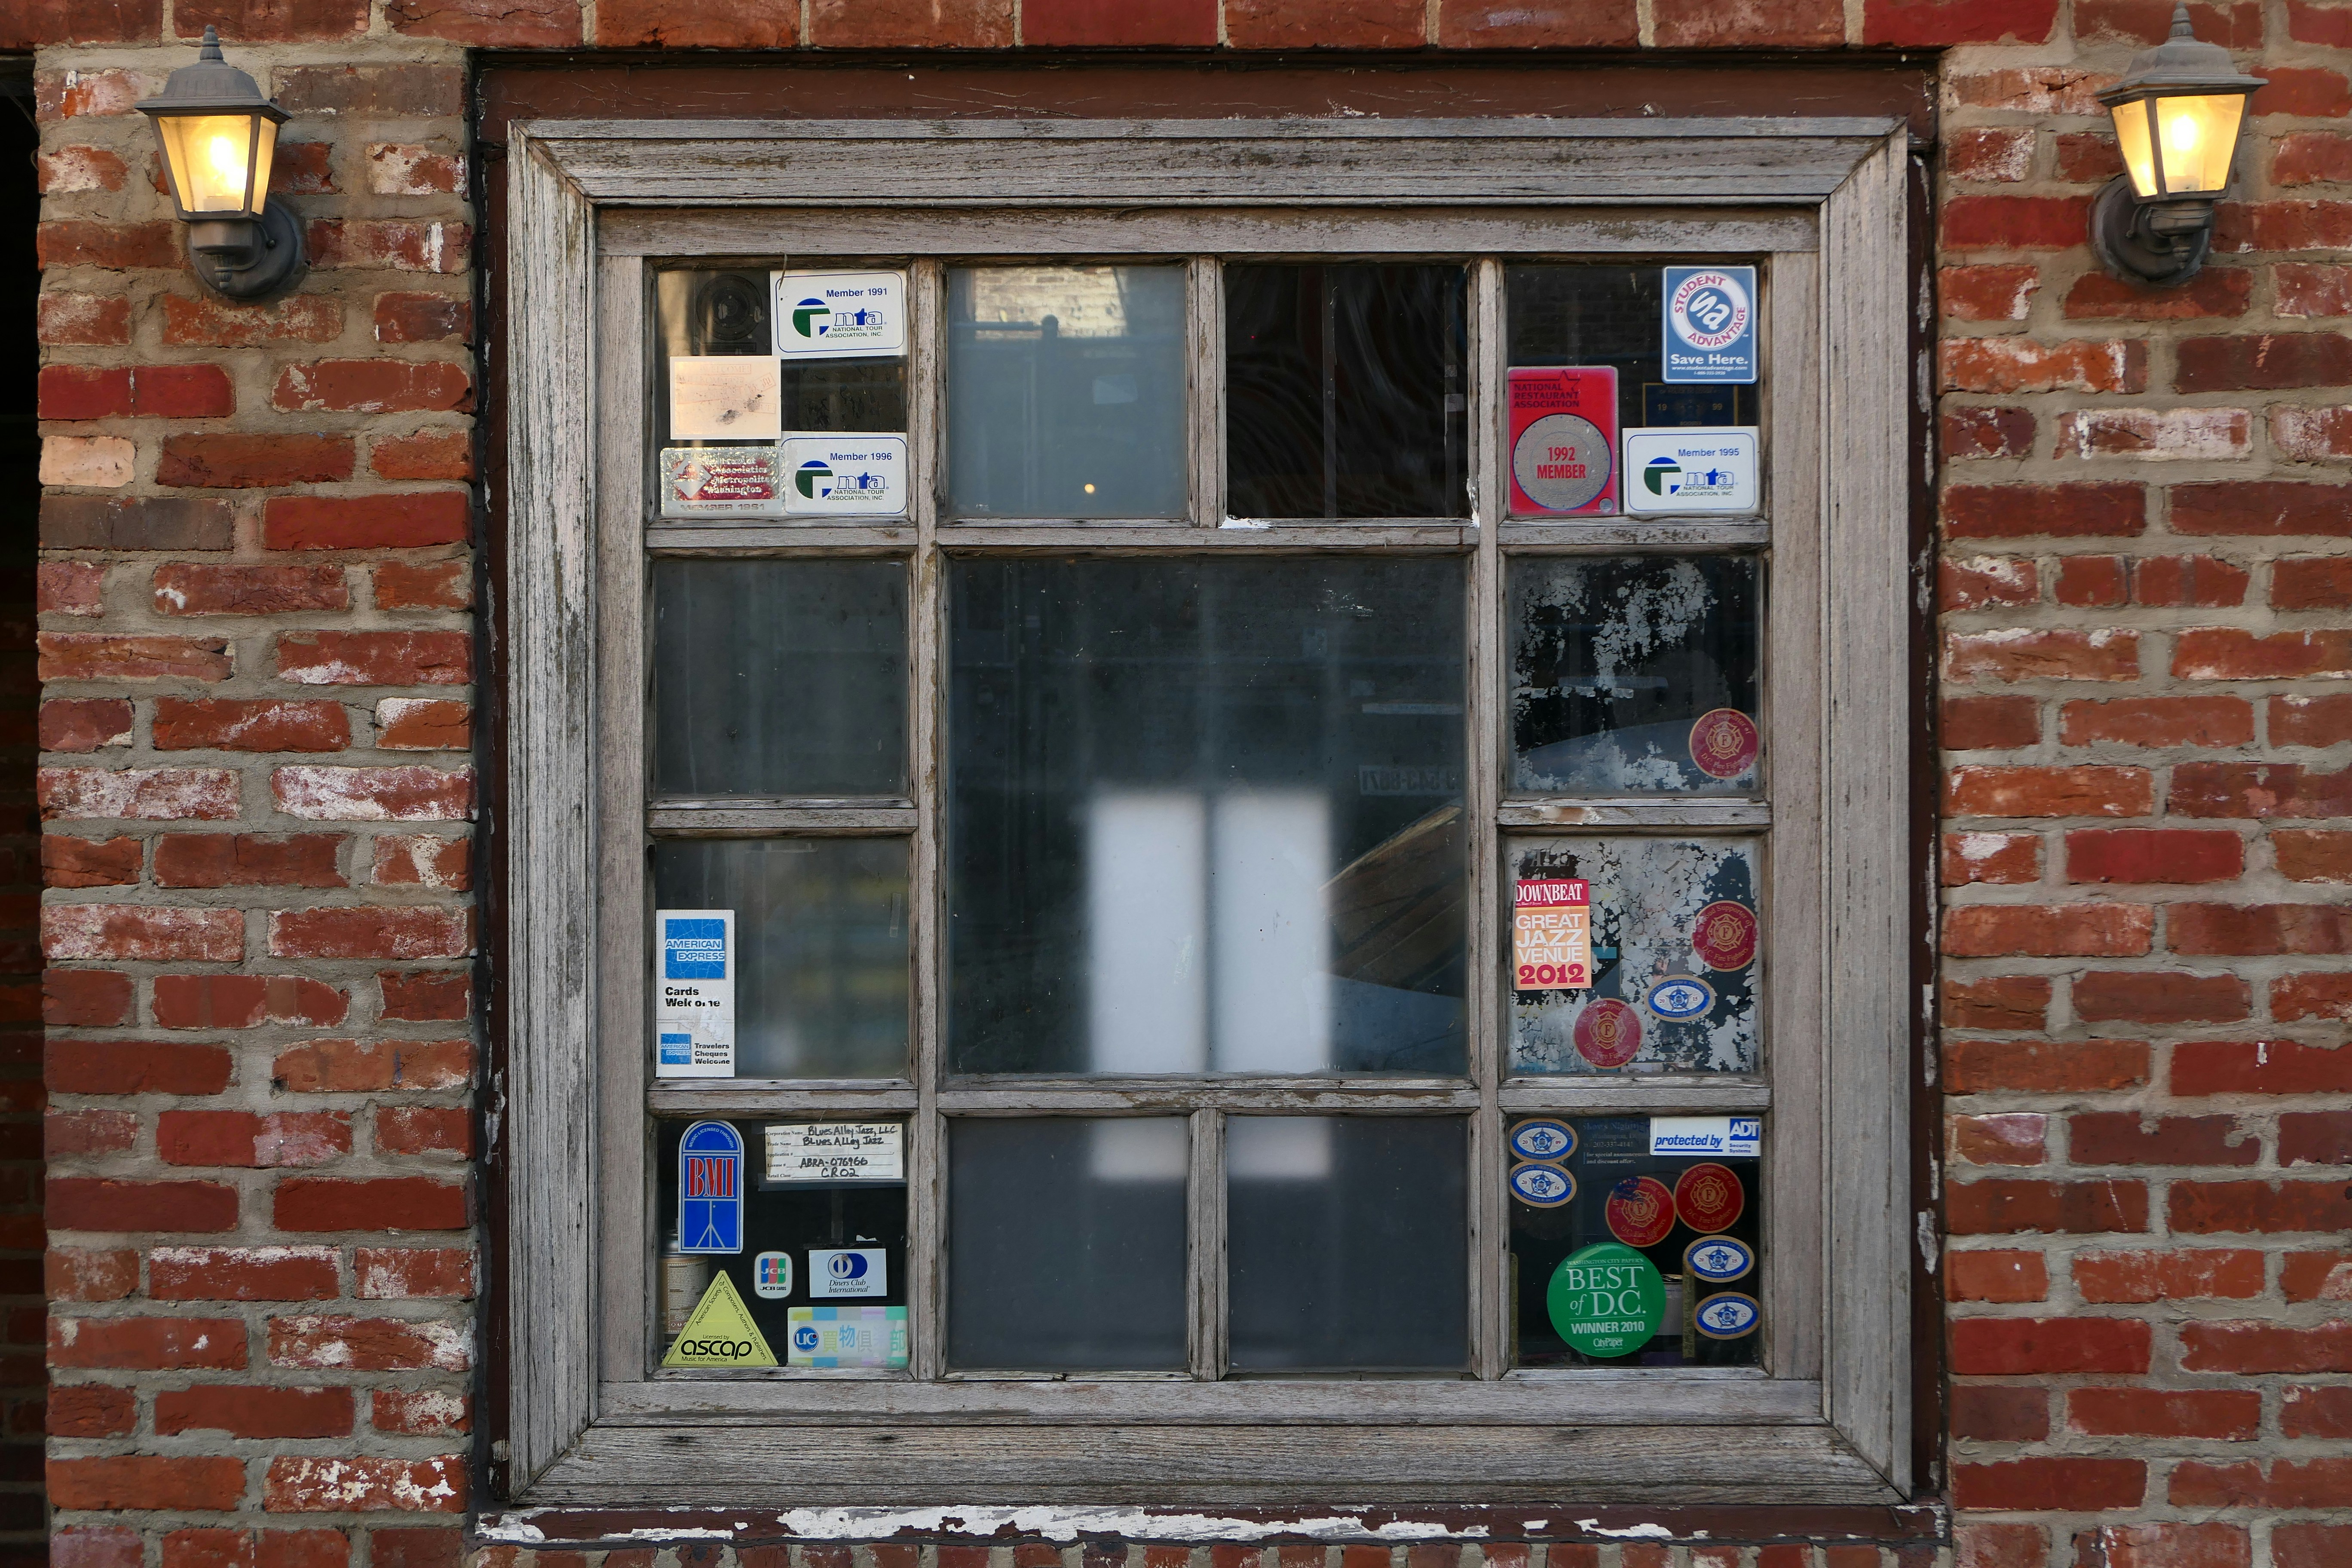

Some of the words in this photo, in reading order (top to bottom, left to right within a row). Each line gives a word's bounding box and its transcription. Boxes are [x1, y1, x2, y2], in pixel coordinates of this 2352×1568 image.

[827, 289, 864, 297] Member
[867, 288, 887, 296] 1991
[1675, 275, 1726, 313] STUDENT
[1687, 307, 1746, 346] ADVANTAGE
[1670, 354, 1704, 364] Save
[1708, 354, 1749, 364] Here.
[1515, 392, 1579, 400] RESTAURANT
[1548, 447, 1576, 461] 1992
[1537, 465, 1586, 479] MEMBER
[1721, 735, 1728, 745] F
[1516, 883, 1583, 904] DOWNBEAT
[1716, 905, 1748, 919] Supporter
[1516, 914, 1583, 929] GREAT
[1516, 929, 1583, 947] JAZZ
[1723, 927, 1729, 937] F
[666, 940, 721, 949] AMERICAN
[678, 952, 724, 961] EXPRESS
[1517, 947, 1583, 963] VENUE
[1702, 945, 1713, 957] D.C.
[1727, 947, 1749, 961] Fighters
[1519, 964, 1584, 984] 2012
[666, 987, 699, 995] Cards
[1605, 1025, 1611, 1035] F
[1730, 1121, 1759, 1136] ADT
[689, 1133, 698, 1148] MUSIC
[720, 1130, 734, 1148] THROUGH
[1655, 1134, 1709, 1148] protected
[1710, 1134, 1723, 1148] by
[688, 1158, 735, 1197] BMI
[1683, 1171, 1698, 1188] Proud
[1699, 1168, 1729, 1179] Supporter
[1706, 1189, 1712, 1200] F
[1566, 1266, 1644, 1290] BEST
[1570, 1294, 1587, 1315] of
[1590, 1290, 1647, 1316] D.C.
[695, 1304, 711, 1326] American
[709, 1288, 722, 1304] Society
[723, 1286, 739, 1313] Composers,
[738, 1313, 751, 1332] Authors
[752, 1336, 767, 1361] Publishers.
[1571, 1321, 1619, 1334] WINNER
[1621, 1321, 1645, 1332] 2010
[681, 1340, 752, 1360] ascap
